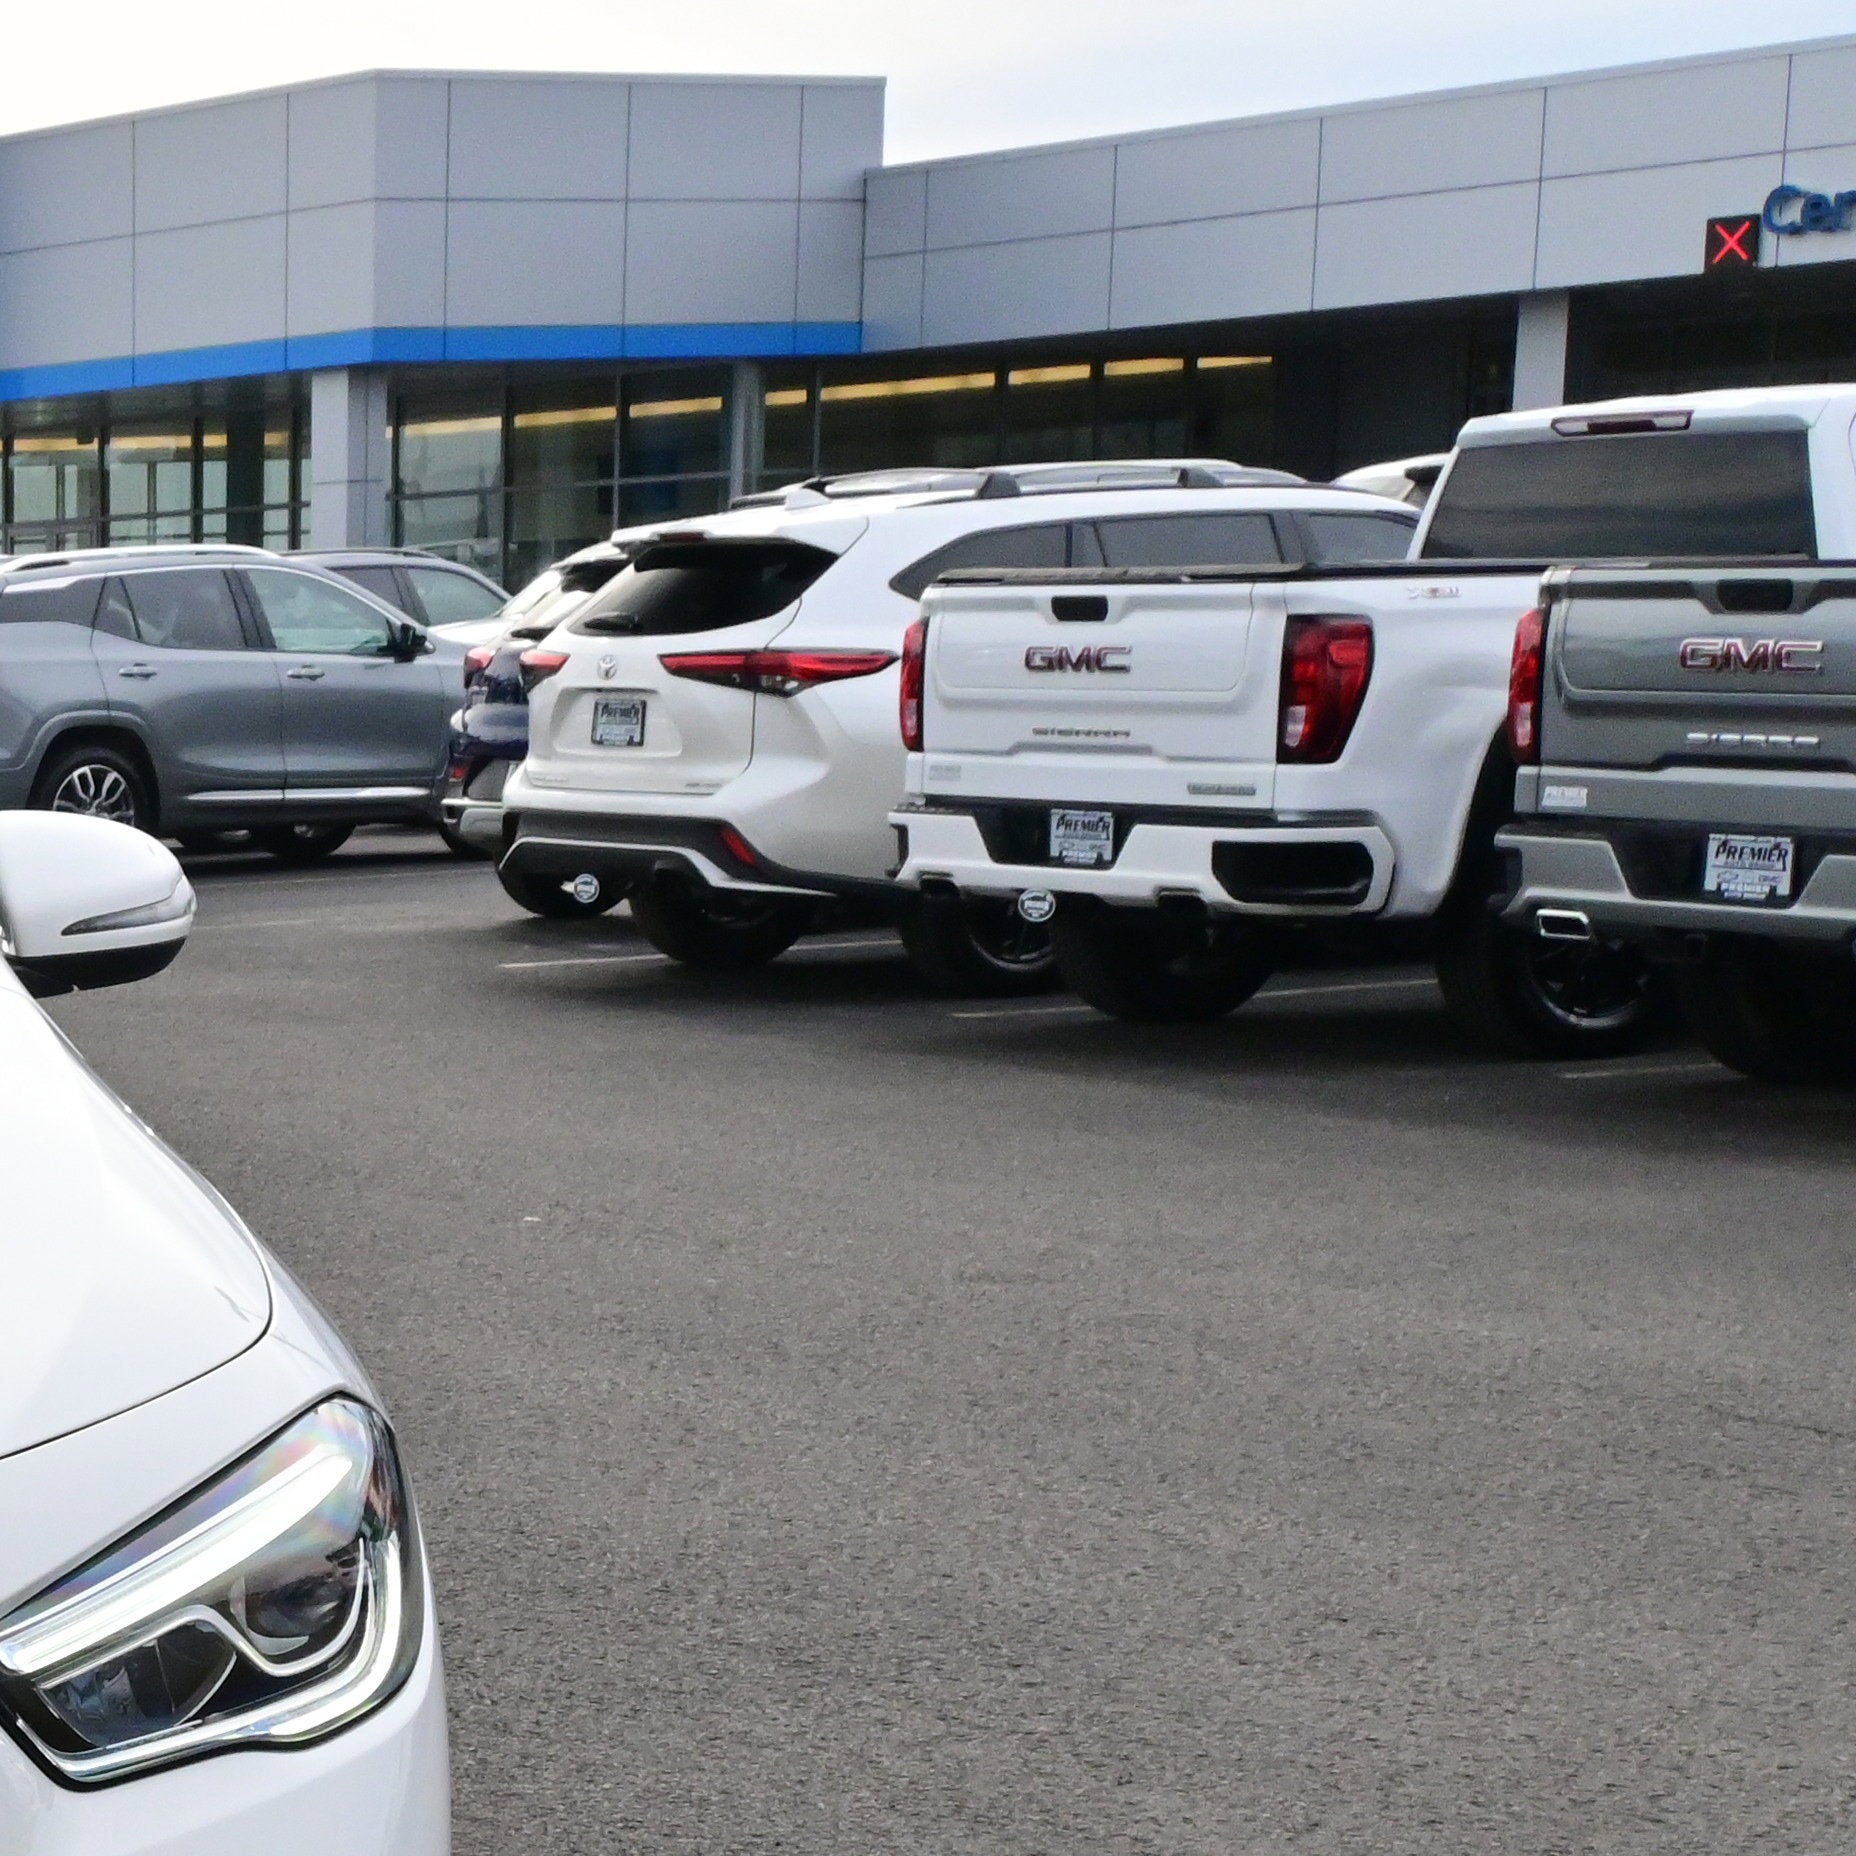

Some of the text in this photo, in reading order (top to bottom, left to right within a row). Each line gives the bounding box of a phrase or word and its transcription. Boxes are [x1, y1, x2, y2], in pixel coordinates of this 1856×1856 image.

[1024, 646, 1132, 673] GMC
[1679, 638, 1825, 672] GMC
[1055, 814, 1111, 841] PREMIER
[1714, 841, 1789, 872] PREMIER
